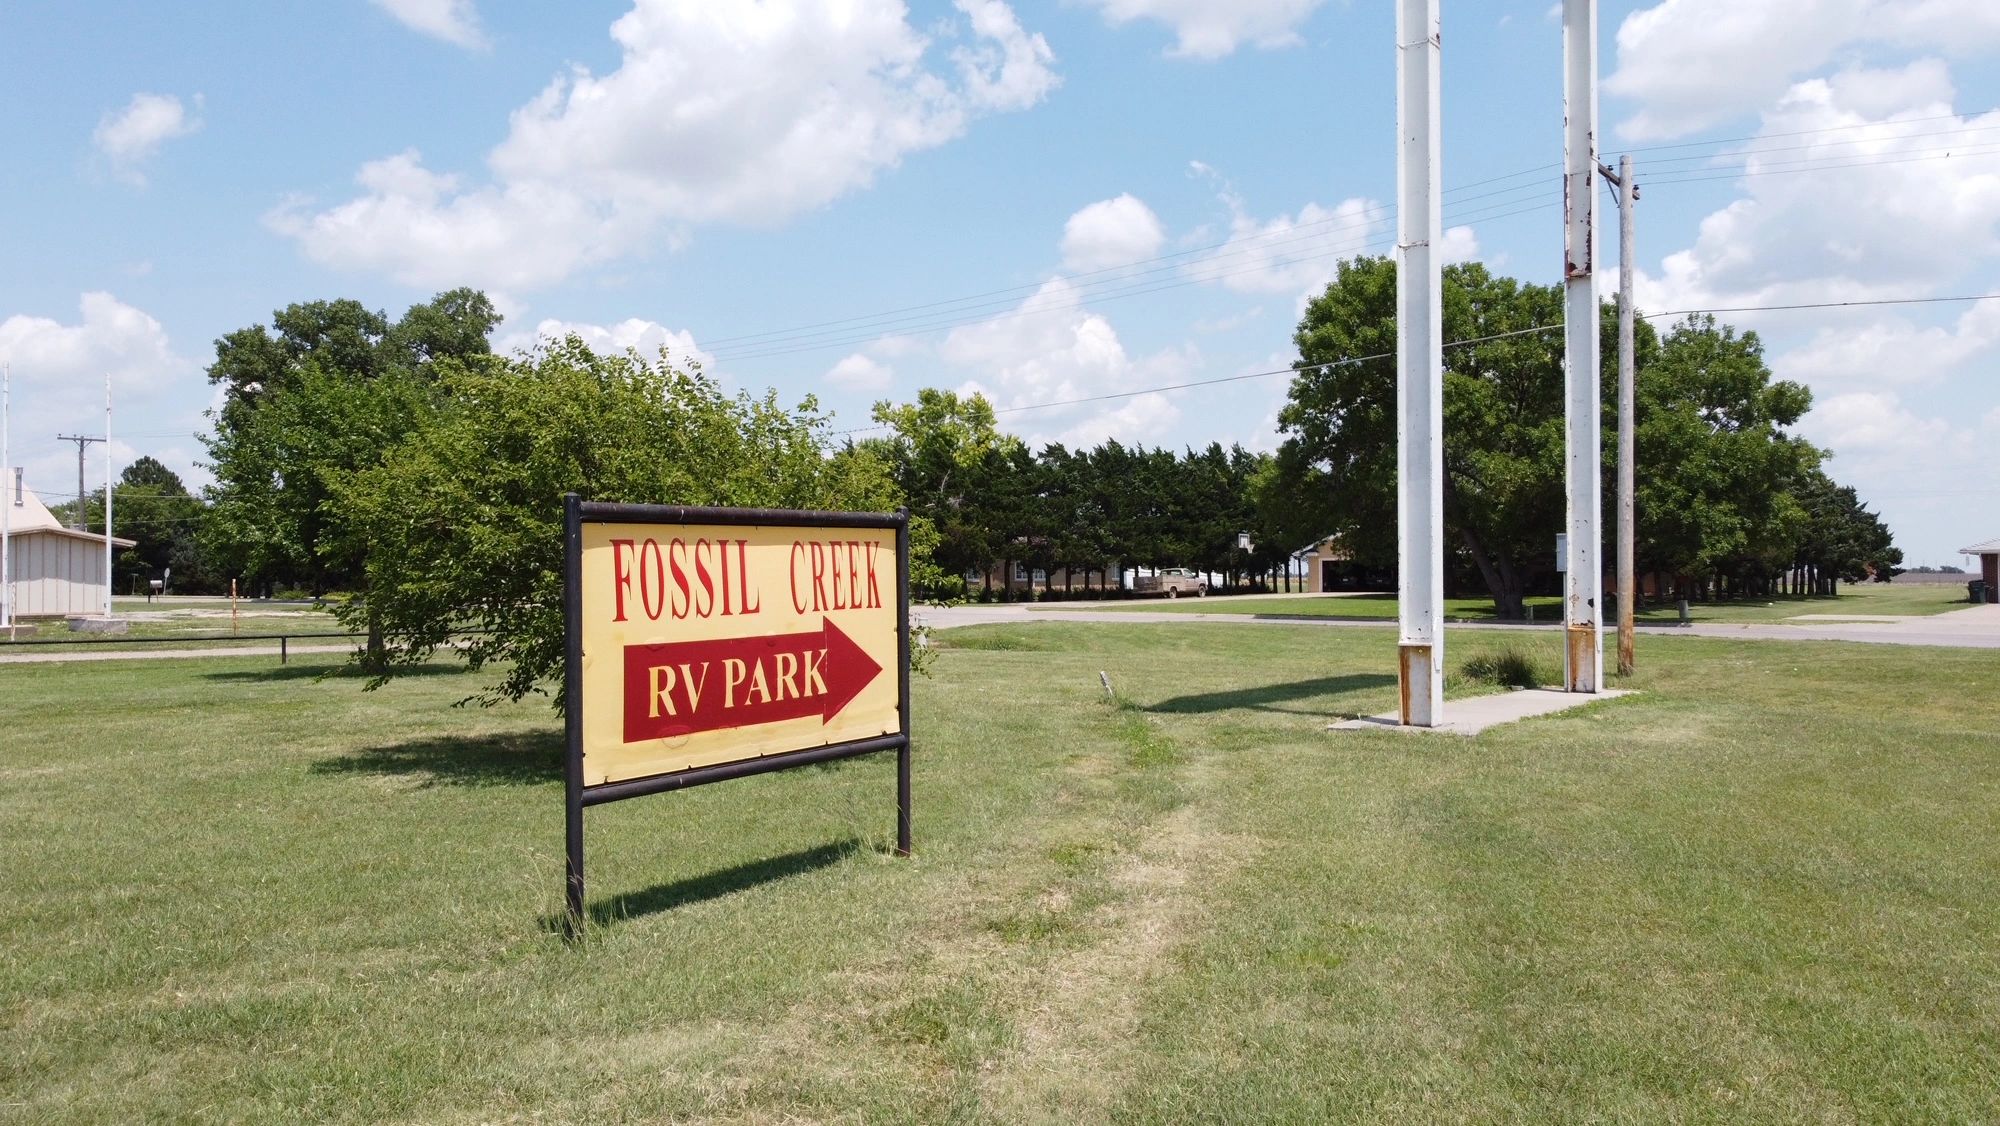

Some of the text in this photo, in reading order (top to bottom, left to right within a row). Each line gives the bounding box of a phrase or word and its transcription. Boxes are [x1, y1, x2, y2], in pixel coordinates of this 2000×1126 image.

[609, 537, 882, 622] FOSSIL CREEK
[648, 648, 828, 718] RV PARK
